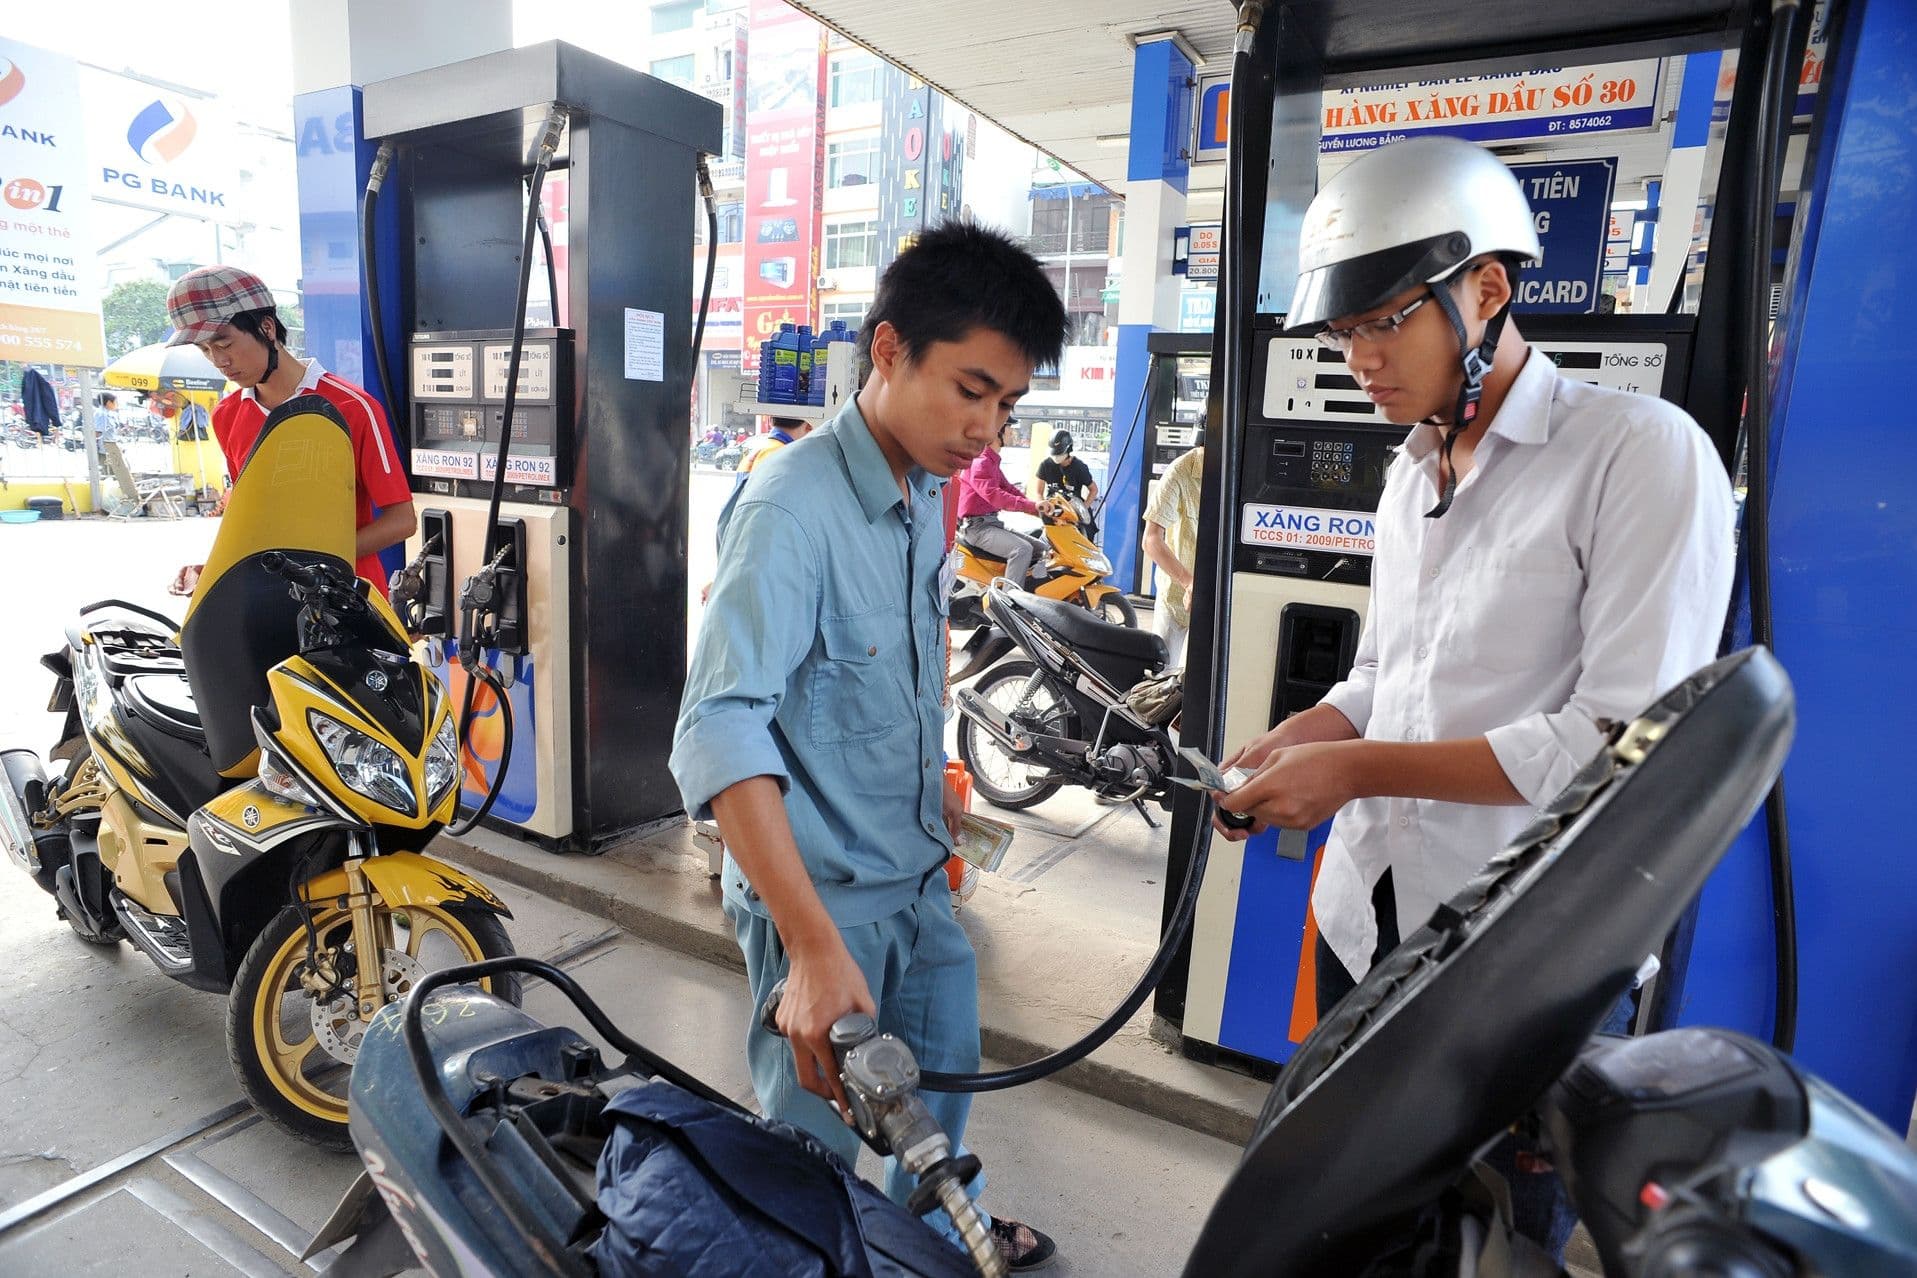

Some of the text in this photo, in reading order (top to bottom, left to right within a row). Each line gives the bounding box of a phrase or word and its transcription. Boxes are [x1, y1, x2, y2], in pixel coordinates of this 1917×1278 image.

[1325, 73, 1636, 128] HÀNG XĂNG DẦU SỐ 30
[1548, 115, 1611, 132] ĐT: 8574062
[103, 167, 224, 207] PG BANK
[1532, 171, 1580, 199] TIÊN
[1530, 210, 1551, 234] G
[1200, 232, 1213, 240] DO
[24, 252, 48, 264] mọi
[53, 256, 74, 266] nơi
[13, 264, 48, 280] Xăng
[51, 269, 76, 281] dầu
[1513, 280, 1588, 304] ICARD
[1290, 348, 1315, 360] 10 X
[1604, 352, 1664, 368] TỔNG SỐ
[132, 377, 148, 386] 099
[416, 453, 473, 467] XĂNG RON 92
[486, 457, 512, 470] XĂG
[515, 460, 536, 472] RON
[539, 462, 550, 473] 92
[1255, 509, 1375, 536] XĂNG RON
[1253, 529, 1283, 541] TCCS
[1286, 532, 1302, 544] 01:
